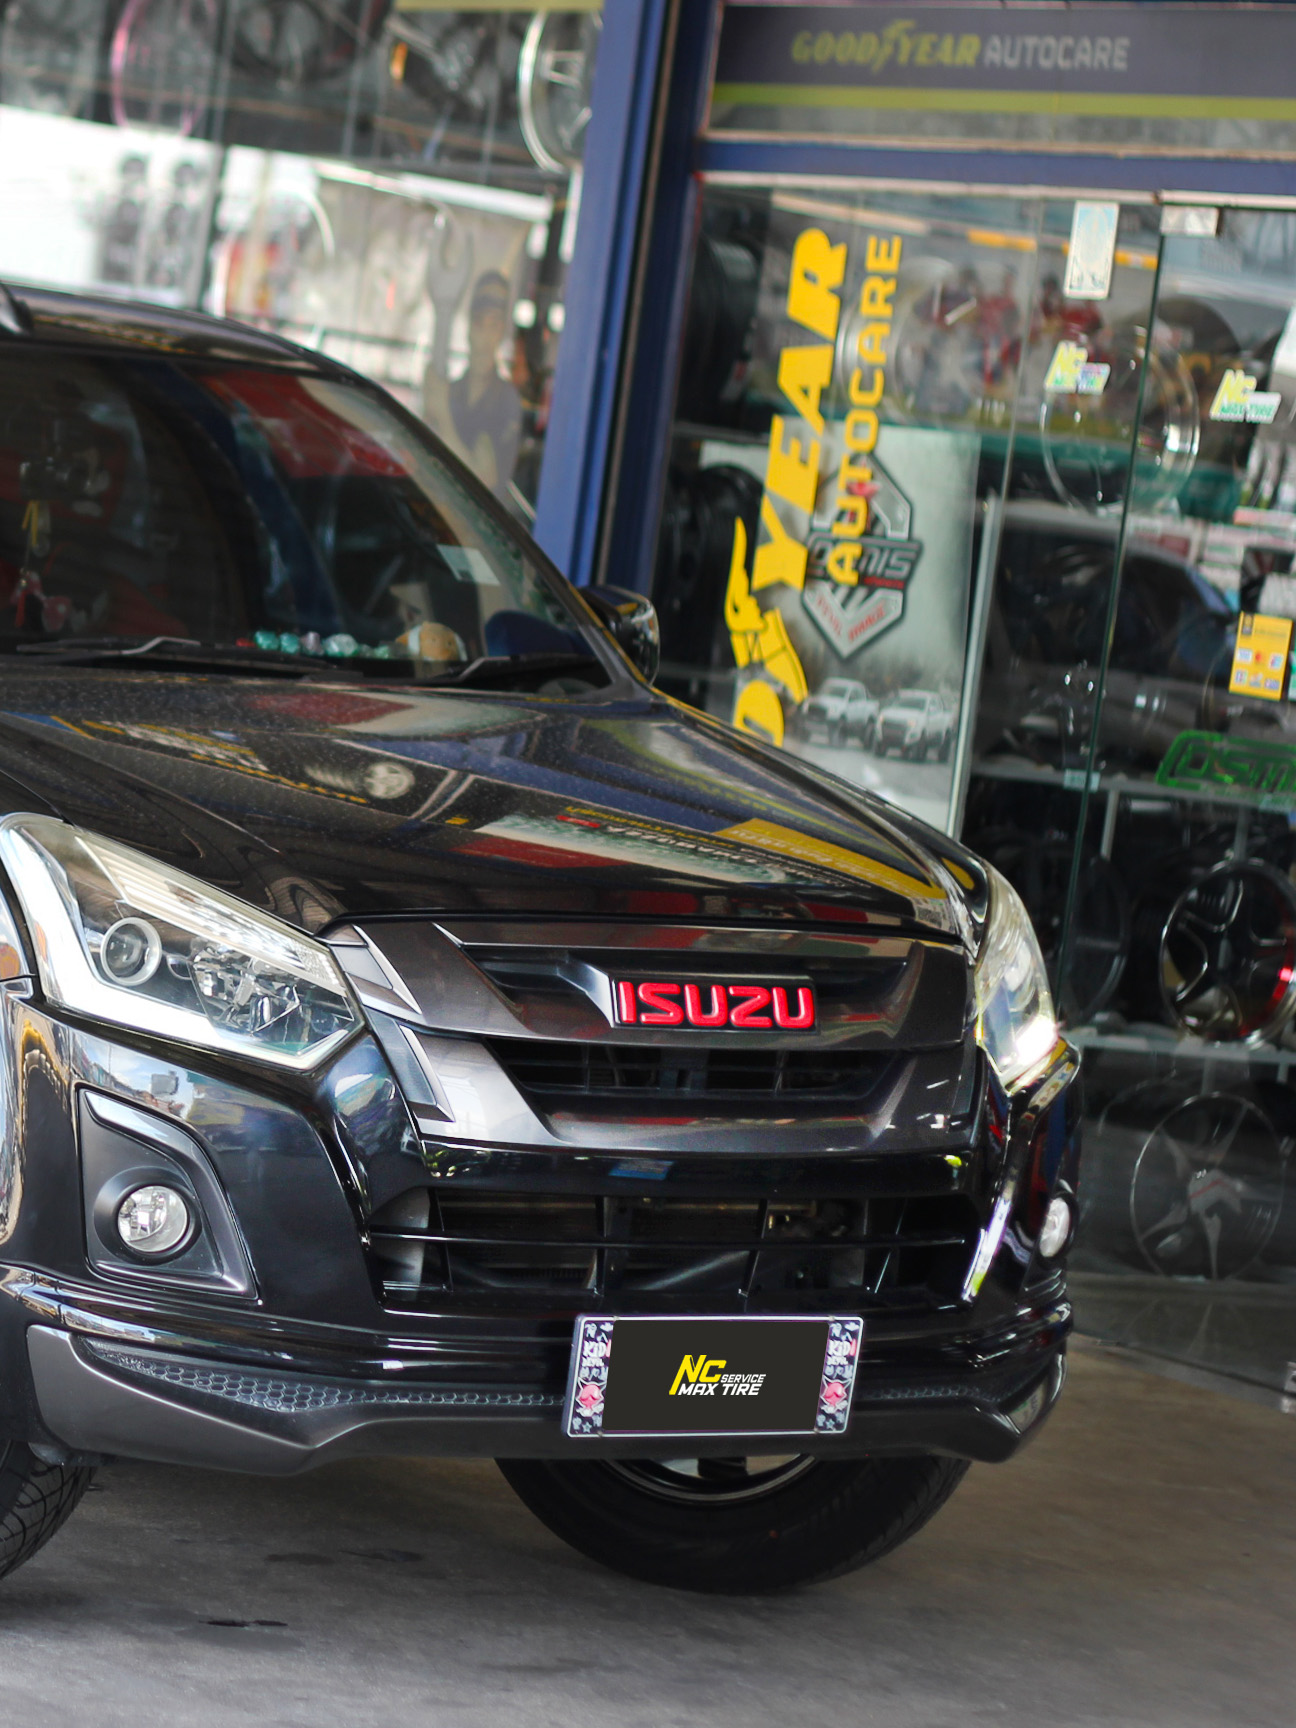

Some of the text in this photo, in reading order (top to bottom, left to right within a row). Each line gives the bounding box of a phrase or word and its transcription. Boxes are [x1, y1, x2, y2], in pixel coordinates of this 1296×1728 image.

[792, 20, 1130, 74] GOODYEAR AUTOCARE
[826, 236, 902, 585] AUTOCARE
[618, 981, 815, 1029] ISUZU
